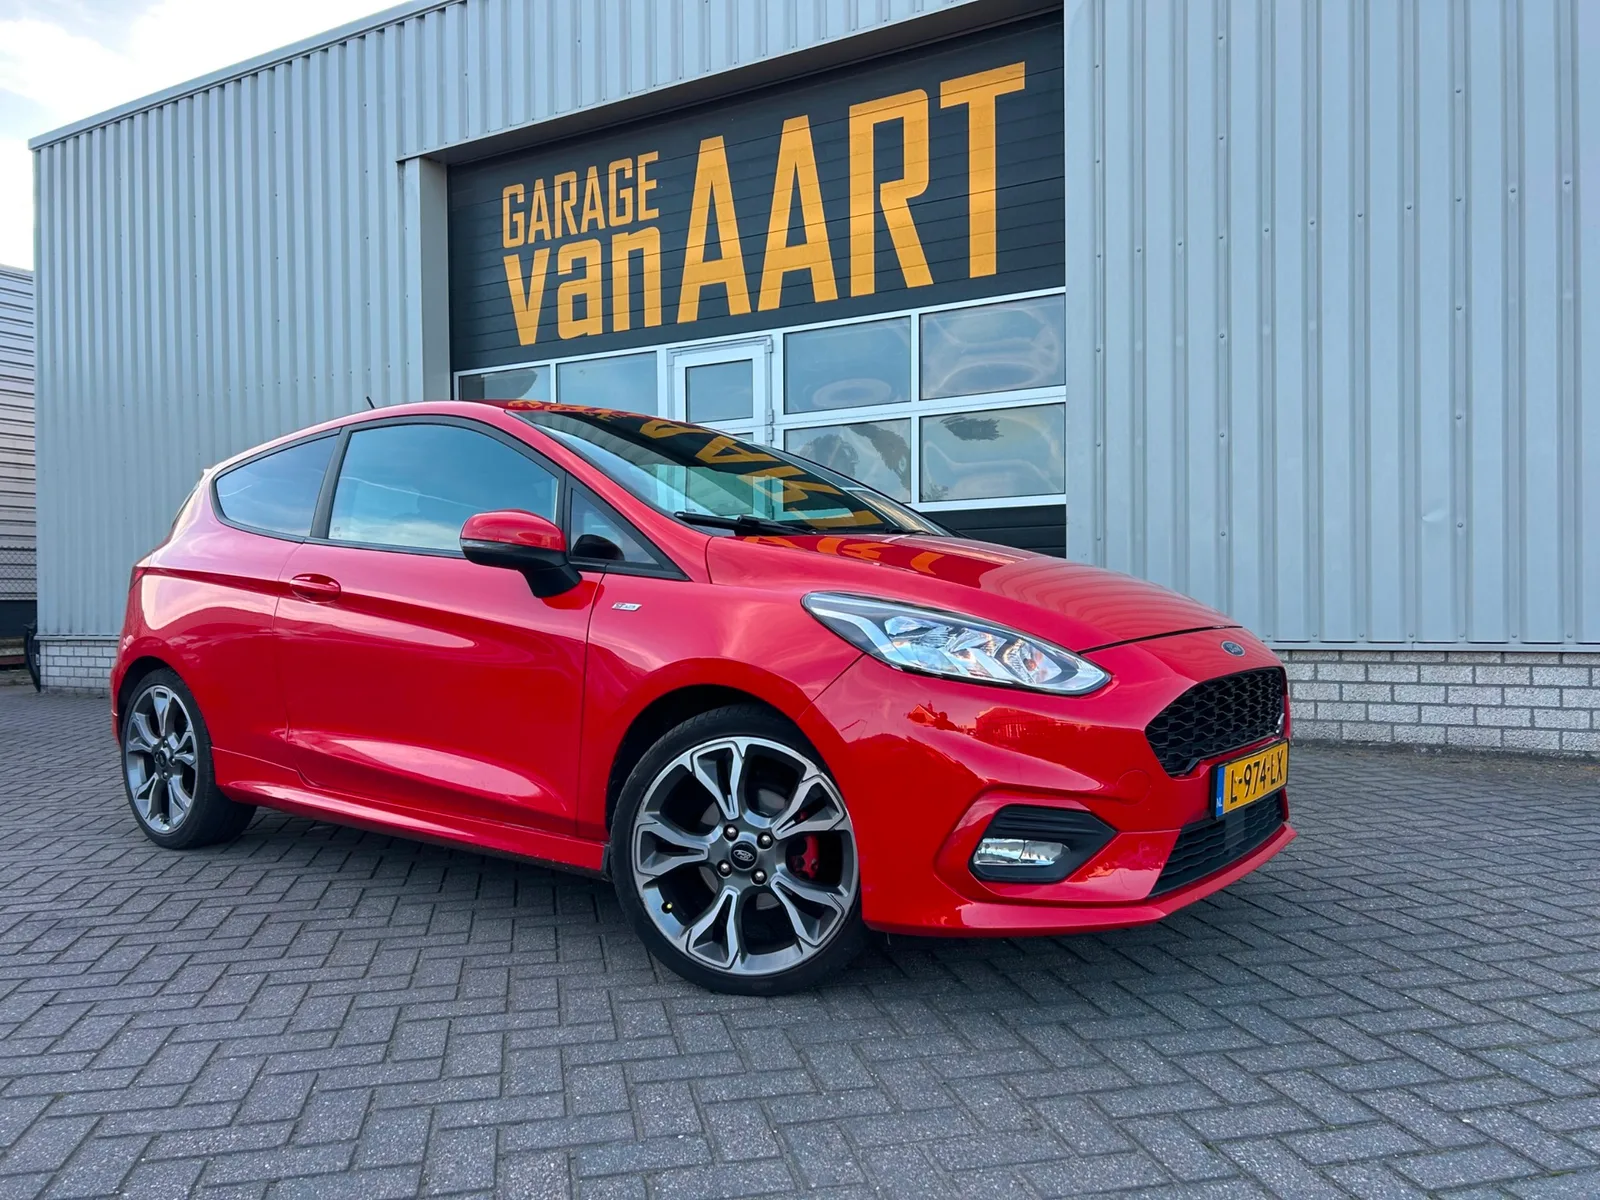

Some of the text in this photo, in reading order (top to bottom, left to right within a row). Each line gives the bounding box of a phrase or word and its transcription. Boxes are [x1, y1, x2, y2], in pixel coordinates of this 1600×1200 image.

[502, 151, 660, 249] GARAGE
[503, 61, 1026, 346] van AART
[1230, 749, 1284, 804] L-974-LX
